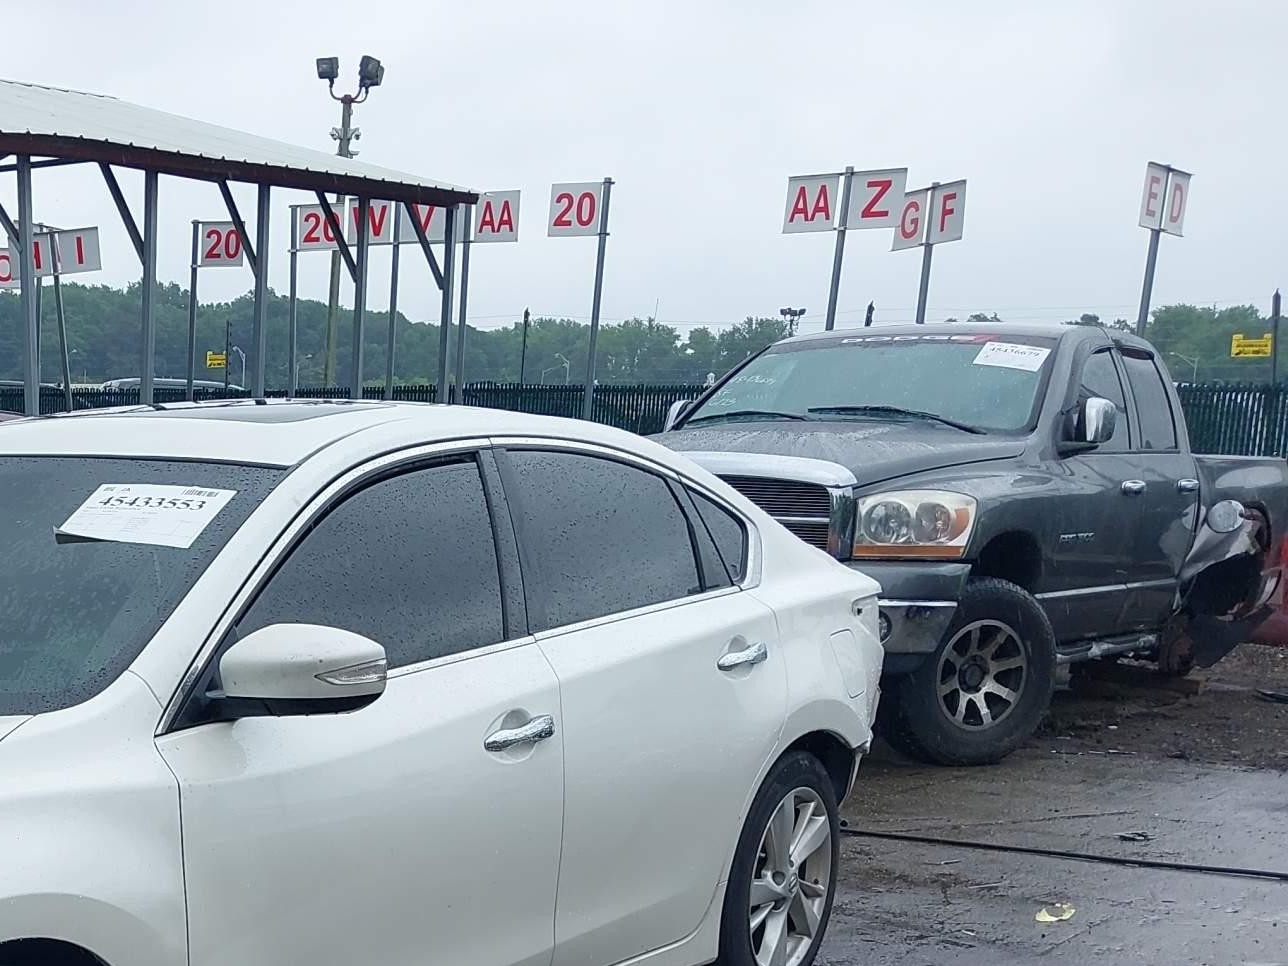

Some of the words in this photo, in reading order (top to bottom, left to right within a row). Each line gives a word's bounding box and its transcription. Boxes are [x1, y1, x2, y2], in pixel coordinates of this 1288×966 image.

[553, 192, 596, 227] 20
[789, 184, 830, 223] AA
[860, 180, 892, 218] Z
[940, 192, 956, 232] F
[1145, 176, 1160, 218] E
[1169, 183, 1183, 223] D
[303, 212, 340, 243] 20
[479, 200, 513, 233] AA
[900, 201, 920, 239] G
[205, 229, 242, 259] 20
[99, 496, 206, 511] 45433553
